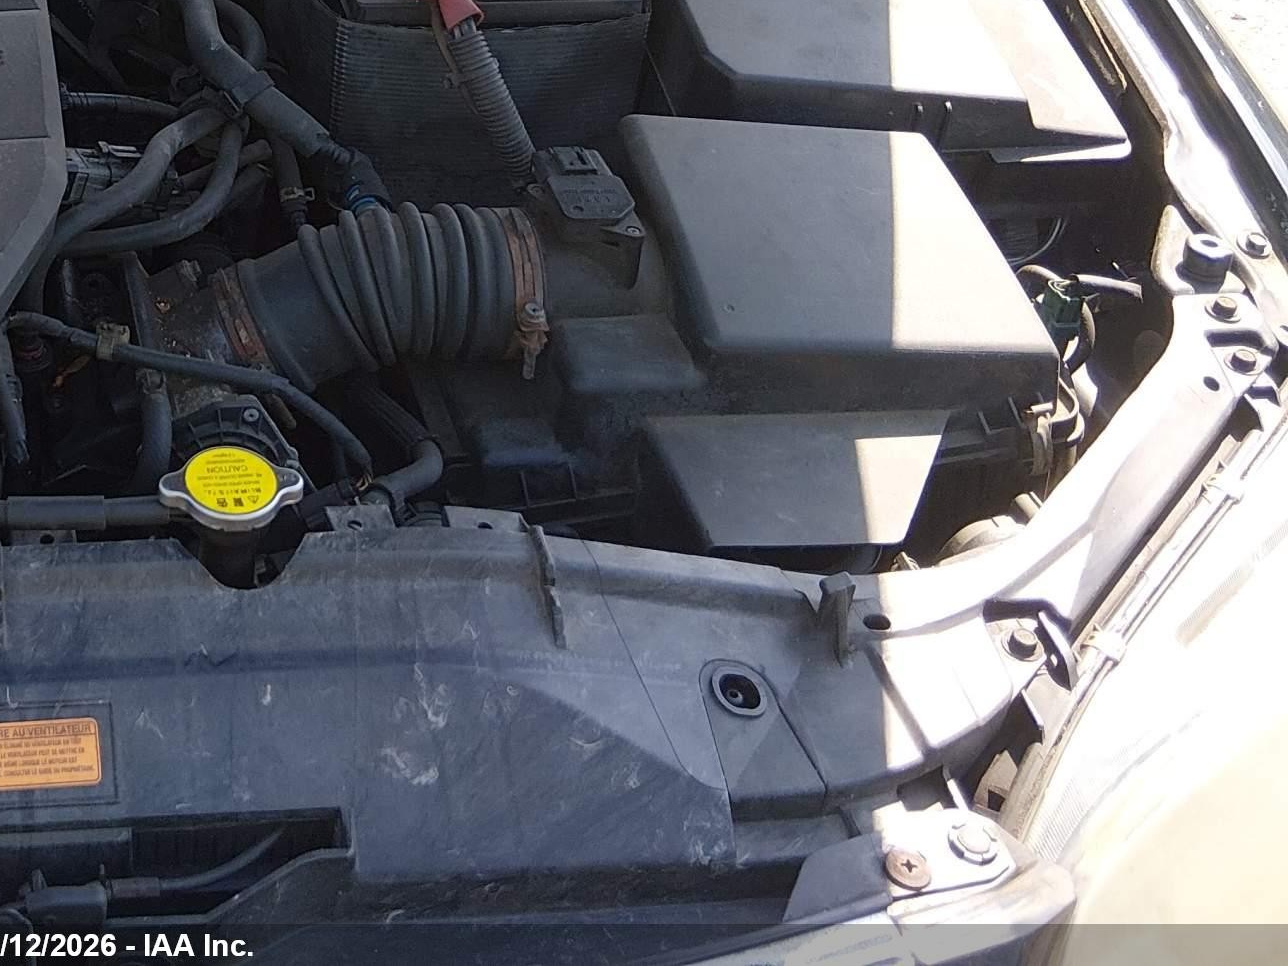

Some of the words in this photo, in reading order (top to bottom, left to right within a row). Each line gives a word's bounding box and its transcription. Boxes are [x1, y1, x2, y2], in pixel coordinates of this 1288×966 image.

[206, 465, 248, 474] CAUTION
[13, 728, 25, 737] AU
[28, 724, 91, 735] VENTILATEUR
